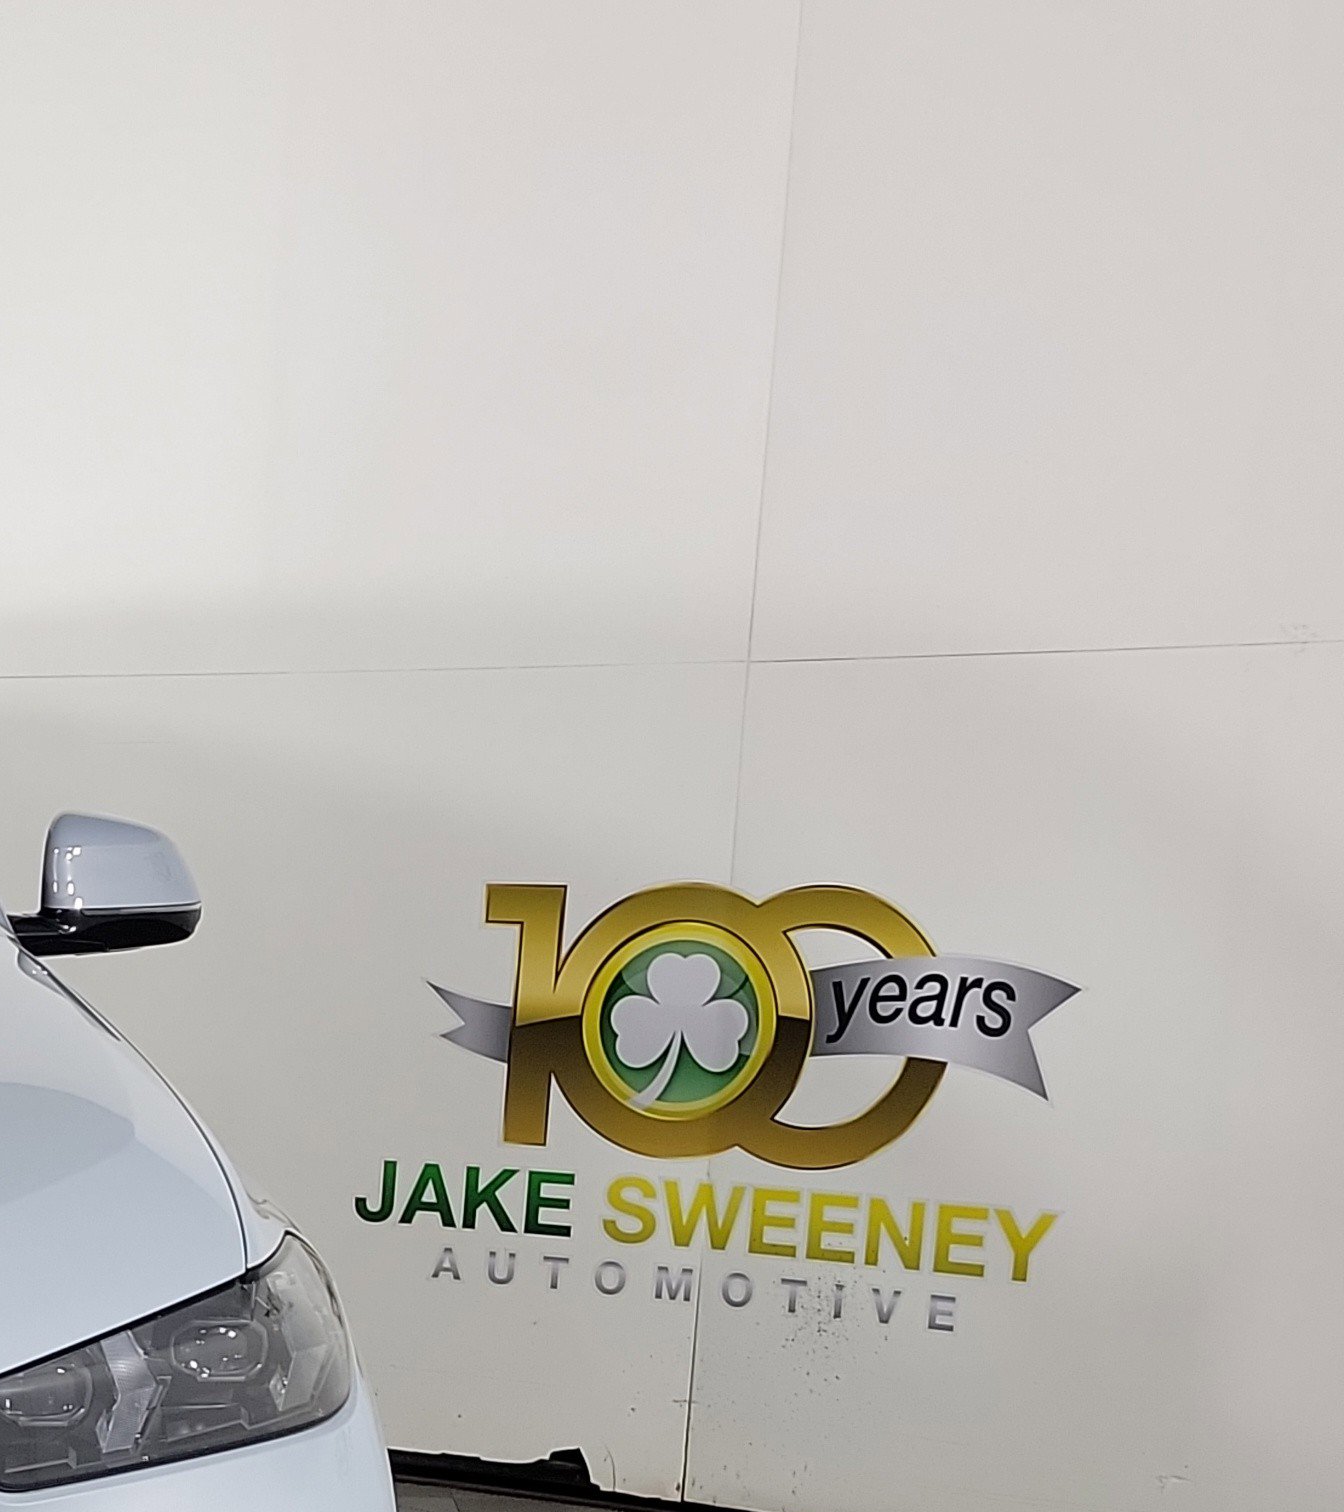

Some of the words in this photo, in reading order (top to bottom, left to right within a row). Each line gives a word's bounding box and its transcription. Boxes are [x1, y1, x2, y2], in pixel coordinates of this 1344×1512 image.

[826, 971, 1017, 1043] years
[353, 1159, 574, 1238] JAKE
[602, 1175, 1056, 1282] SWEENEY
[431, 1247, 956, 1332] AUTOMOTIVE
